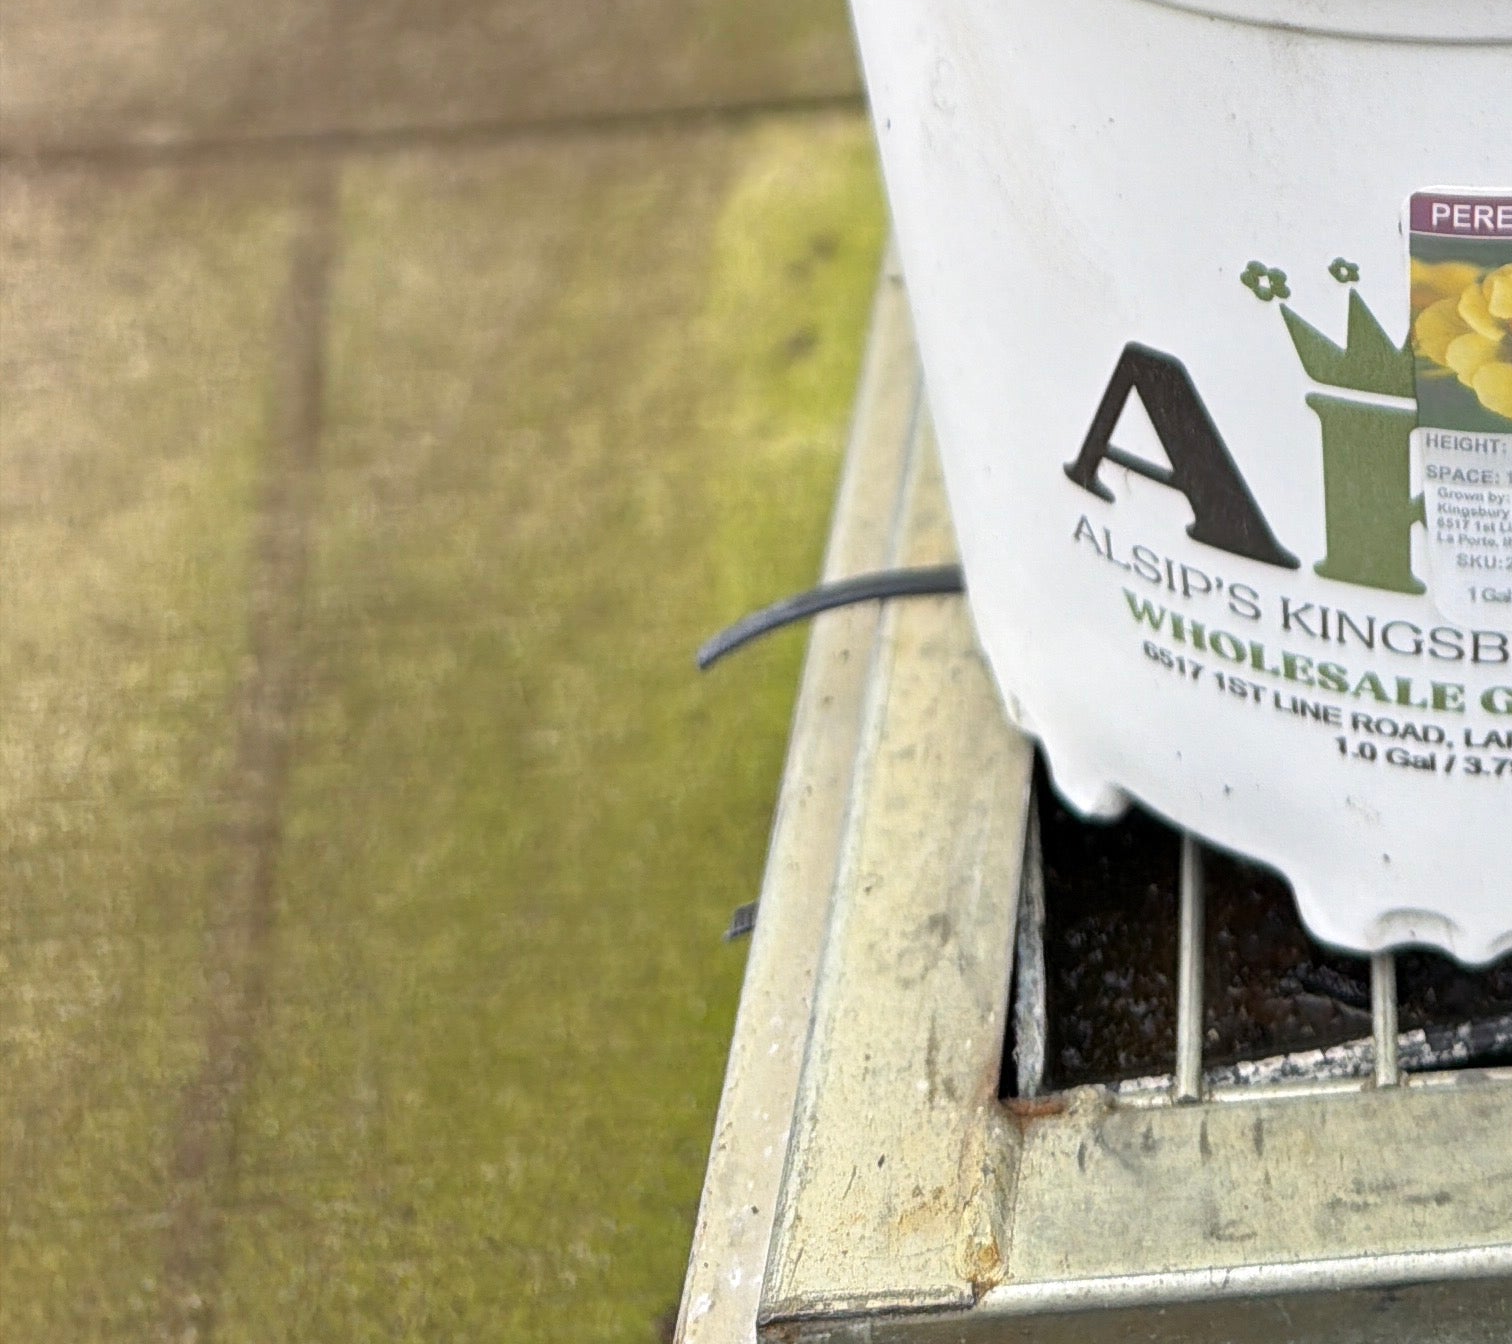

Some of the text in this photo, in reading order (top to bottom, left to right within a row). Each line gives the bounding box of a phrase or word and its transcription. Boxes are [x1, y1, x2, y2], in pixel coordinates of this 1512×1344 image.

[1426, 432, 1507, 454] HEIGHT:
[1426, 464, 1500, 484] SPACE:
[1437, 487, 1484, 501] Grown
[1437, 502, 1509, 520] Kingsbury
[1474, 520, 1496, 533] 1st
[1437, 531, 1454, 545] La
[1073, 515, 1262, 621] ALSIP'S
[1468, 586, 1477, 603] 1
[1481, 585, 1512, 604] Gal
[1122, 586, 1466, 713] WHOLESALE
[1142, 639, 1204, 682] 6517
[1214, 670, 1266, 703] 1ST
[1274, 690, 1342, 727] LINE
[1351, 712, 1454, 749] ROAD,
[1335, 735, 1378, 762] 1.0
[1385, 747, 1435, 772] Gal
